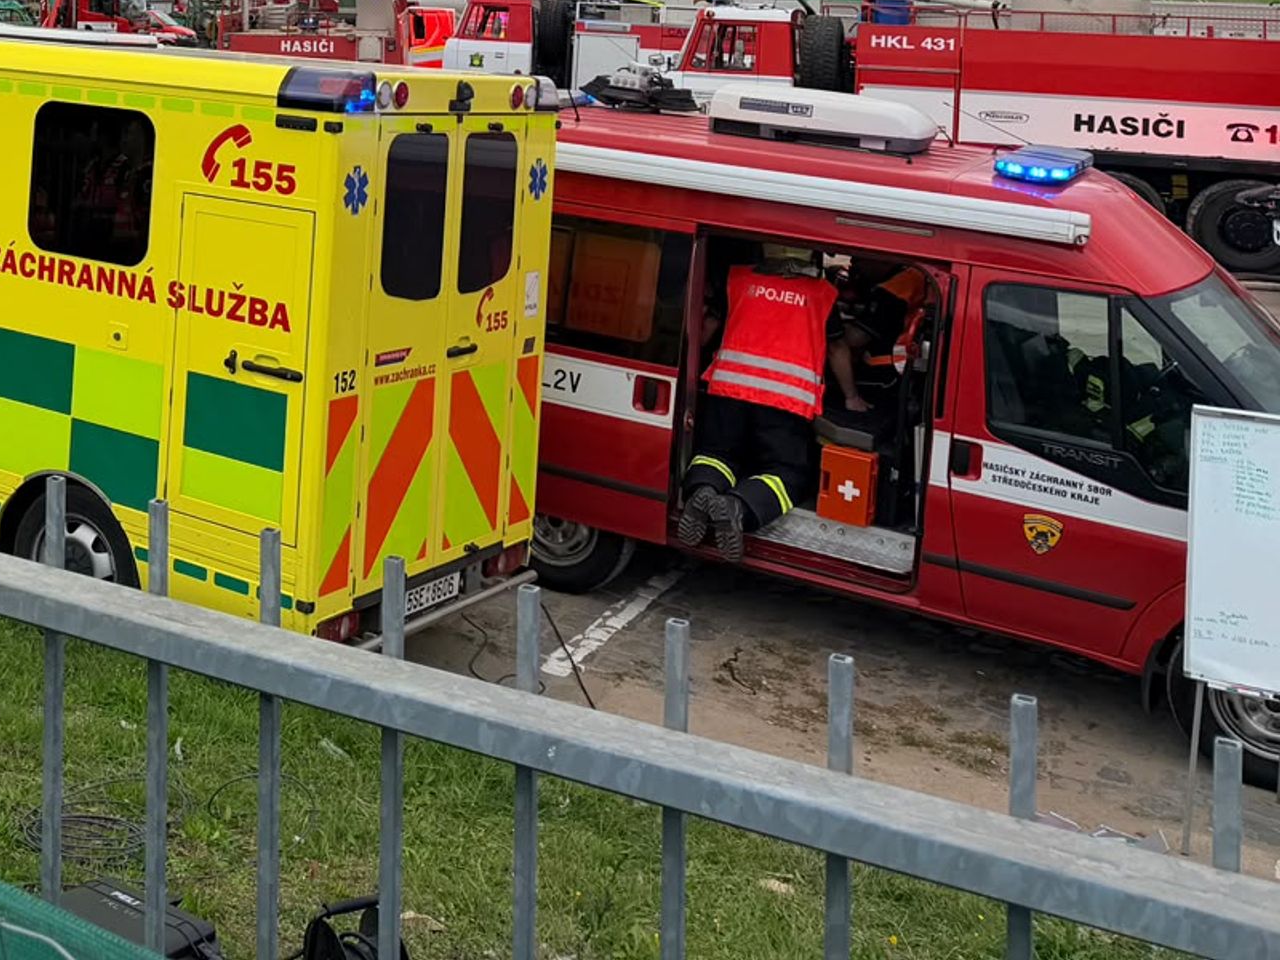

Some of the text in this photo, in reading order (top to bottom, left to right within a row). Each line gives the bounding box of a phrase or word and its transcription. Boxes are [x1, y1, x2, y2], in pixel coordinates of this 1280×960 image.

[281, 38, 334, 53] HASIČI
[871, 35, 955, 51] HKL 431
[1073, 113, 1280, 144] HASIČI 1
[231, 157, 297, 196] 155
[167, 280, 291, 333] SLUŽBA
[486, 311, 508, 333] 155
[334, 370, 356, 394] 152
[1041, 442, 1124, 469] TRANSIT
[983, 461, 1112, 496] HASIČSKÝ ZÁCHRANNÝ SBOR
[991, 473, 1100, 505] STŘEDOČESKÉHO KRAJE
